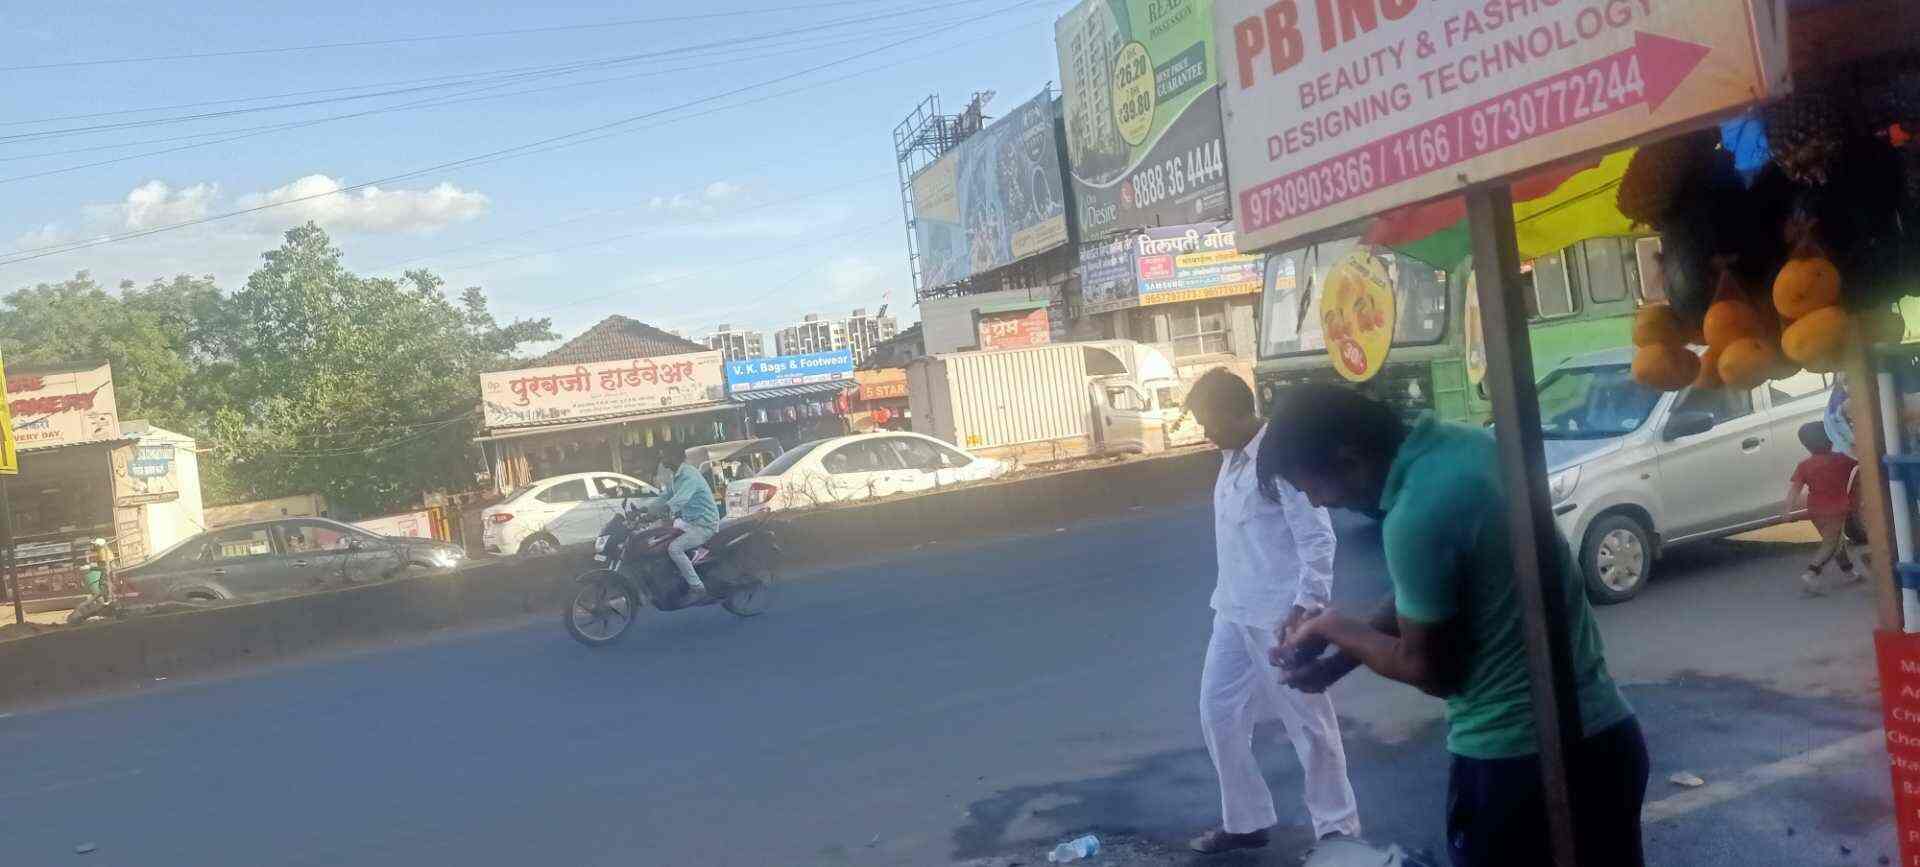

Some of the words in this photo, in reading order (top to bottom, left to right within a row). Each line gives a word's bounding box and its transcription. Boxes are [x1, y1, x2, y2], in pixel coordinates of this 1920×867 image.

[1233, 0, 1304, 90] PB
[1316, 0, 1419, 51] IN
[1299, 38, 1405, 109] BEAUTY
[1415, 30, 1436, 59] &
[1250, 151, 1374, 226] 9730903366
[1393, 123, 1450, 176] 1166
[1472, 55, 1646, 151] 9730772244
[1267, 82, 1413, 162] DESIGNING
[1133, 164, 1165, 209] 8888
[1166, 156, 1185, 196] 36
[1187, 138, 1223, 187] 4444
[733, 365, 744, 375] V.
[760, 362, 786, 373] Bags
[789, 360, 798, 369] &
[801, 355, 848, 368] Footwear
[875, 383, 905, 396] STAR
[14, 432, 39, 442] VERY
[41, 430, 60, 440] DAY
